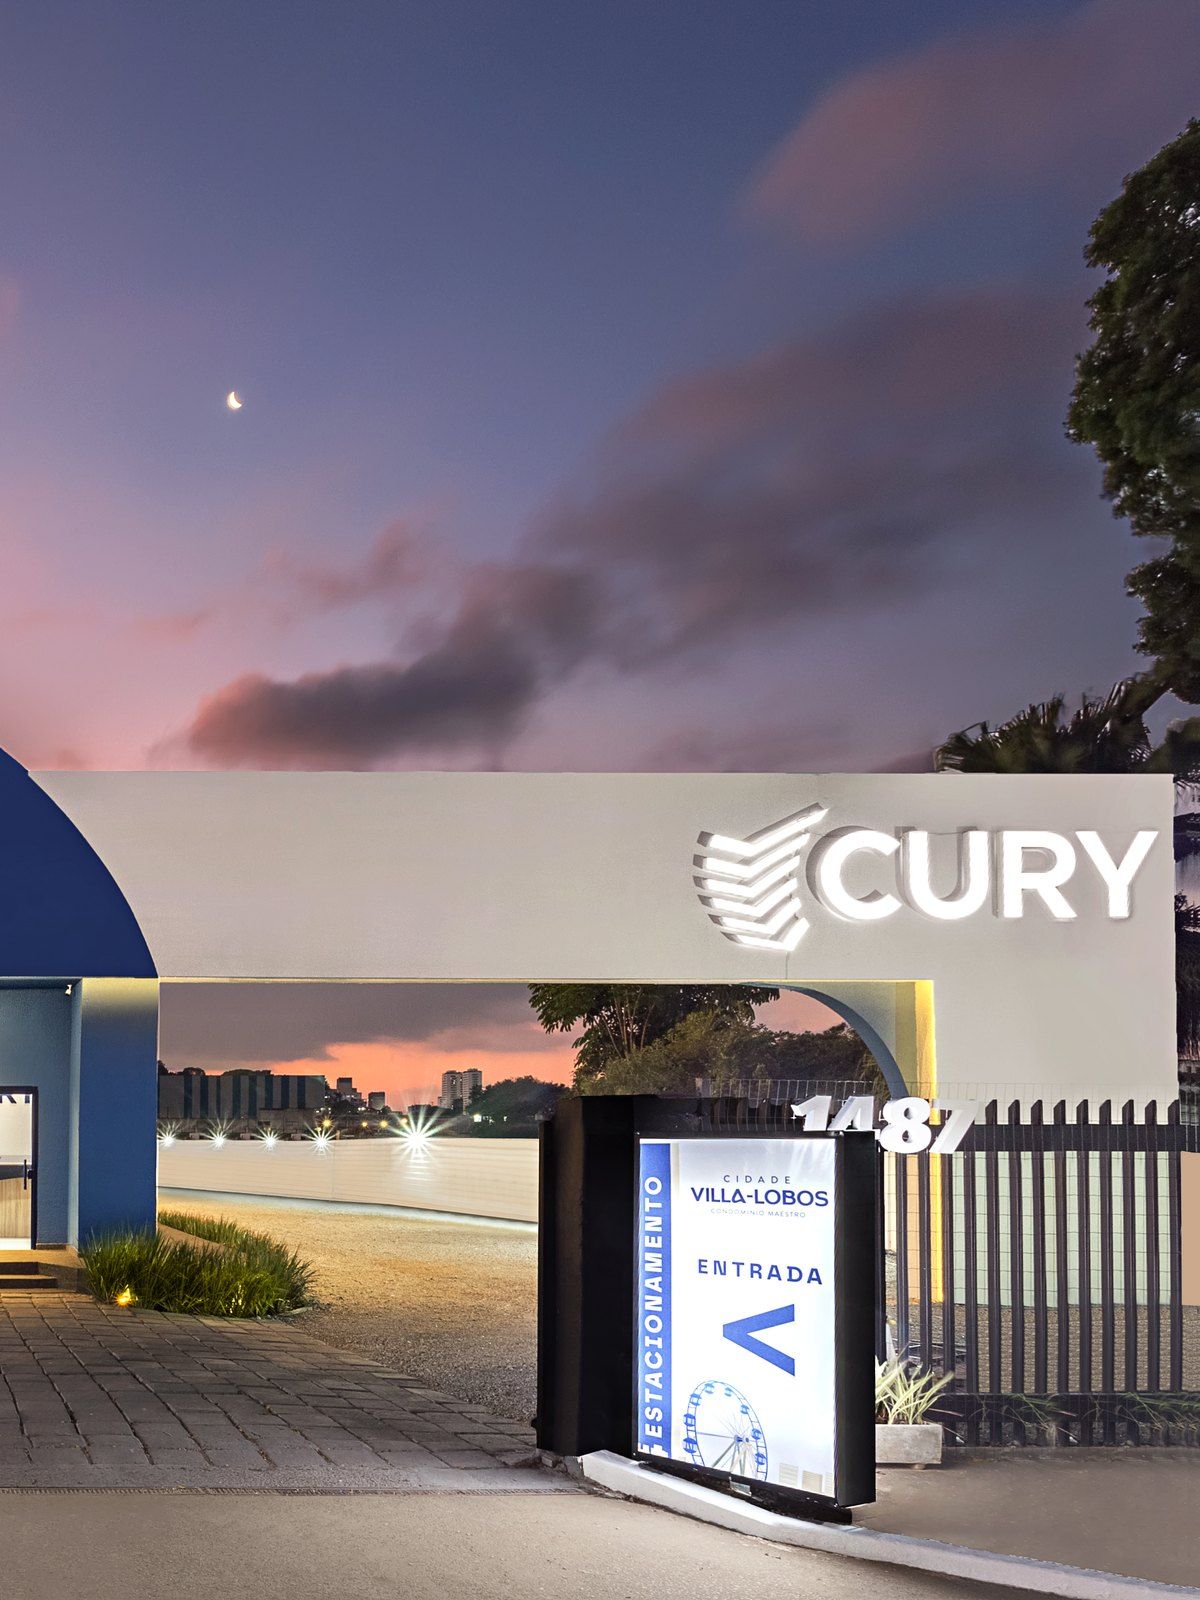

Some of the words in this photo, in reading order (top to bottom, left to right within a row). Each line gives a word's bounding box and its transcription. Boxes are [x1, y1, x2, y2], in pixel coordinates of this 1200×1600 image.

[807, 826, 1159, 921] CURY
[790, 1095, 980, 1154] 1487
[690, 1186, 829, 1207] VILLA-LOBOS
[723, 1174, 791, 1184] CIDADE
[698, 1259, 823, 1285] ENTRADA
[644, 1176, 663, 1438] ESTACIONAMENTO
